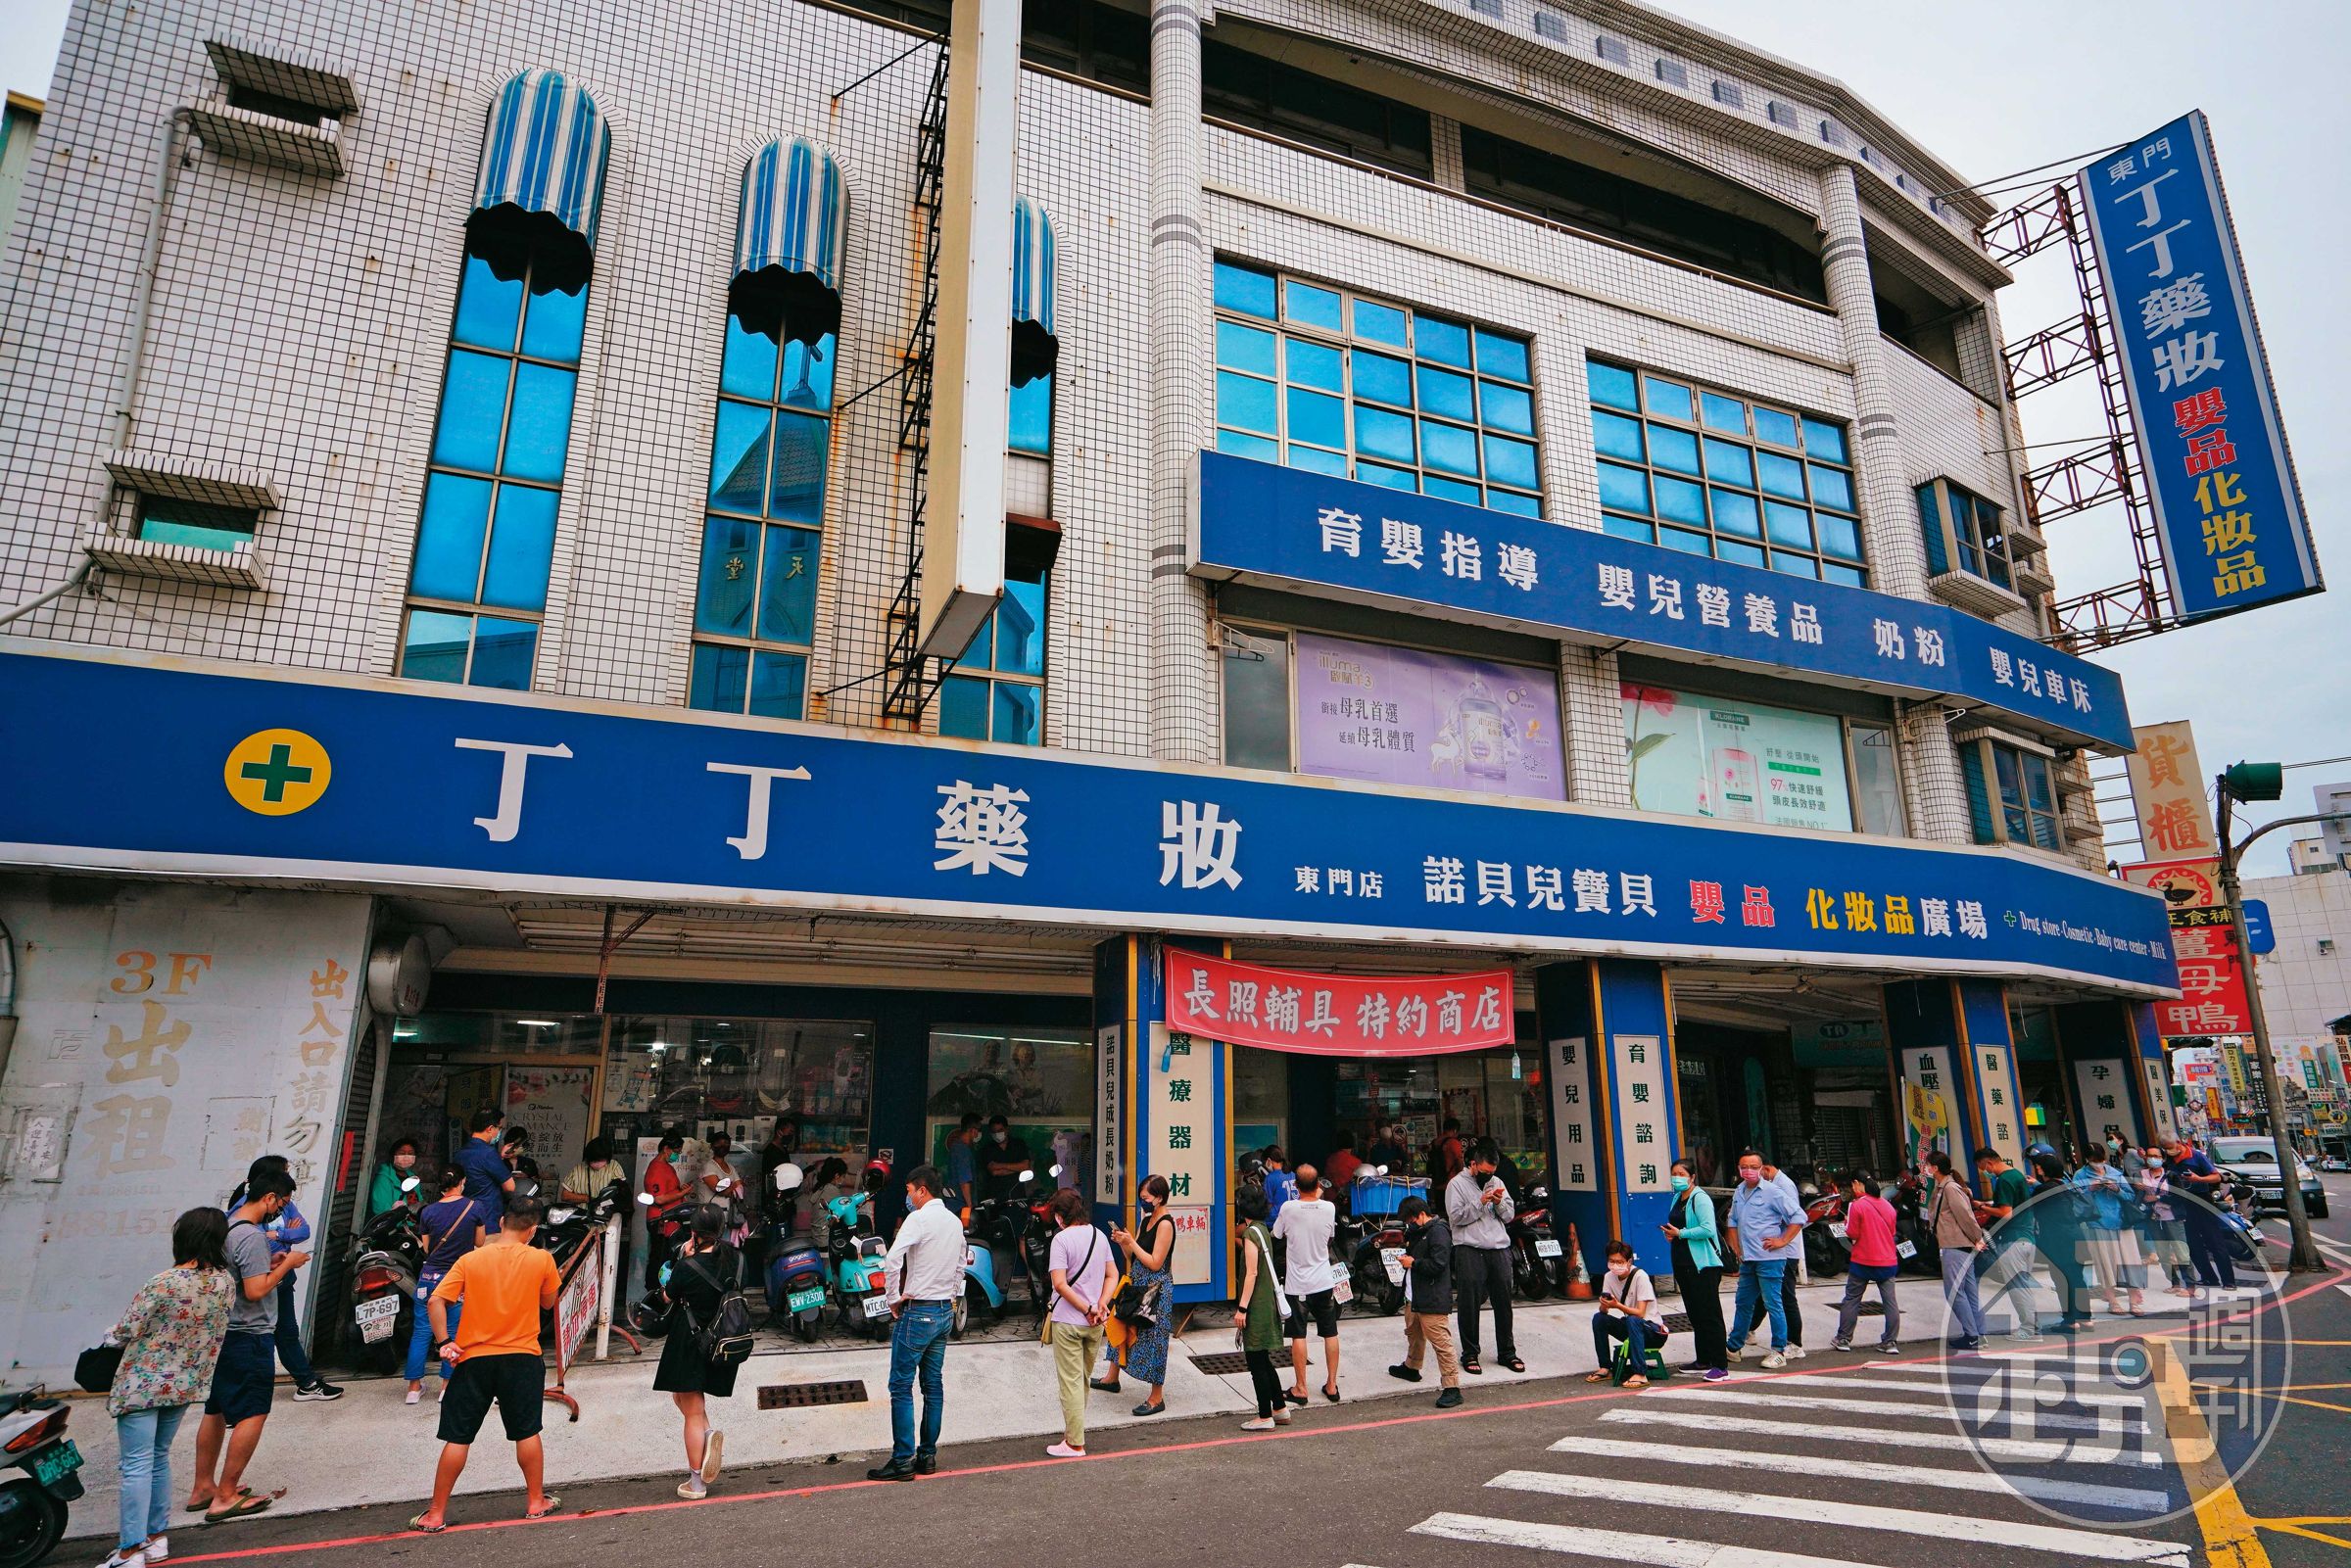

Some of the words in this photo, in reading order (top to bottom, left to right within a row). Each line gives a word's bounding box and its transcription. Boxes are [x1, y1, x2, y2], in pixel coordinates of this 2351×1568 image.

[2107, 136, 2172, 186] 東門
[2114, 168, 2225, 392] 丁丁藥妝
[2173, 386, 2238, 477] 嬰品
[2193, 471, 2267, 598] 化妝品
[1318, 507, 1539, 592] 育嬰指導
[1598, 562, 1823, 645] 嬰兒營養品
[1873, 617, 1945, 668] 奶粉
[1989, 645, 2092, 714] 嬰兒車床
[1319, 655, 1361, 673] illuma
[1339, 726, 1415, 752] 延續母乳體質
[1772, 794, 1827, 813] 頭皮長效舒適
[2135, 735, 2209, 852] 貨櫃
[1294, 866, 1384, 899] 東門店
[1423, 855, 1657, 918] 諾貝兒寶貝
[1690, 879, 1776, 927] 嬰品
[2019, 911, 2040, 935] Drug
[110, 950, 213, 995] 3F
[1183, 969, 1341, 1038] 長照輔具
[1356, 985, 1502, 1039] 特約商店
[2169, 928, 2239, 1032] 薑母鴨
[81, 999, 193, 1180] 出租
[1104, 1034, 1116, 1195] 諾貝兒成長奶粉
[1168, 1032, 1192, 1197] 醫療器材
[1561, 1044, 1586, 1184] 嬰兒用品
[1628, 1043, 1657, 1184] 育嬰諮詢
